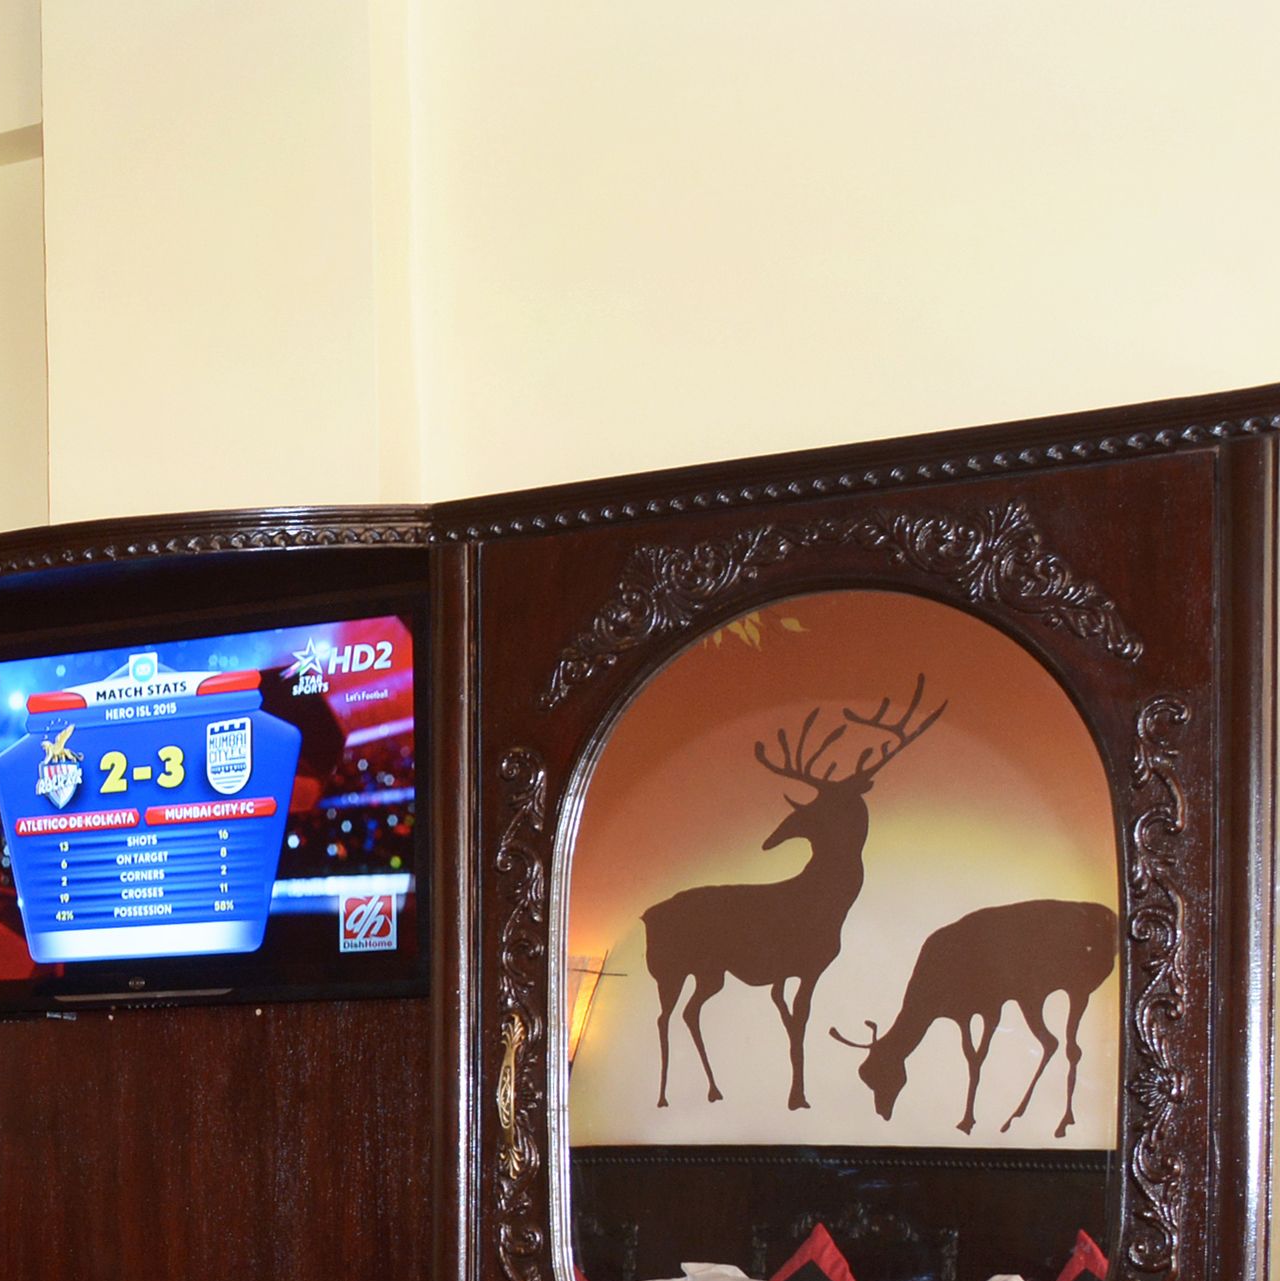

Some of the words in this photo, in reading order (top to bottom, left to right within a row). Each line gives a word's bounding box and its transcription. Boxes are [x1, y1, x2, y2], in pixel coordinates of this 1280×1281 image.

[327, 641, 393, 675] HD2
[292, 682, 329, 696] SPORTS
[299, 675, 323, 686] STAR
[96, 686, 142, 701] MATCH
[147, 681, 187, 696] STATS
[362, 689, 389, 701] Football
[105, 706, 133, 720] HERO
[136, 704, 152, 718] ISL
[153, 702, 177, 716] 2015
[164, 806, 212, 821] MUMBAI
[213, 803, 239, 817] CITY
[240, 801, 255, 815] FC
[18, 816, 68, 833] ATLETICO
[68, 815, 83, 829] DE
[84, 811, 135, 828] KOLKATA
[127, 834, 158, 847] SHOTS
[218, 829, 229, 840] 16
[116, 854, 132, 865] ON
[133, 850, 168, 864] TARGET
[120, 869, 165, 883] CORNERS
[220, 864, 228, 876] 2
[121, 886, 164, 900] CROSSES
[220, 882, 229, 893] 11
[113, 904, 173, 918] POSSESSION
[343, 940, 393, 949] DishHome
